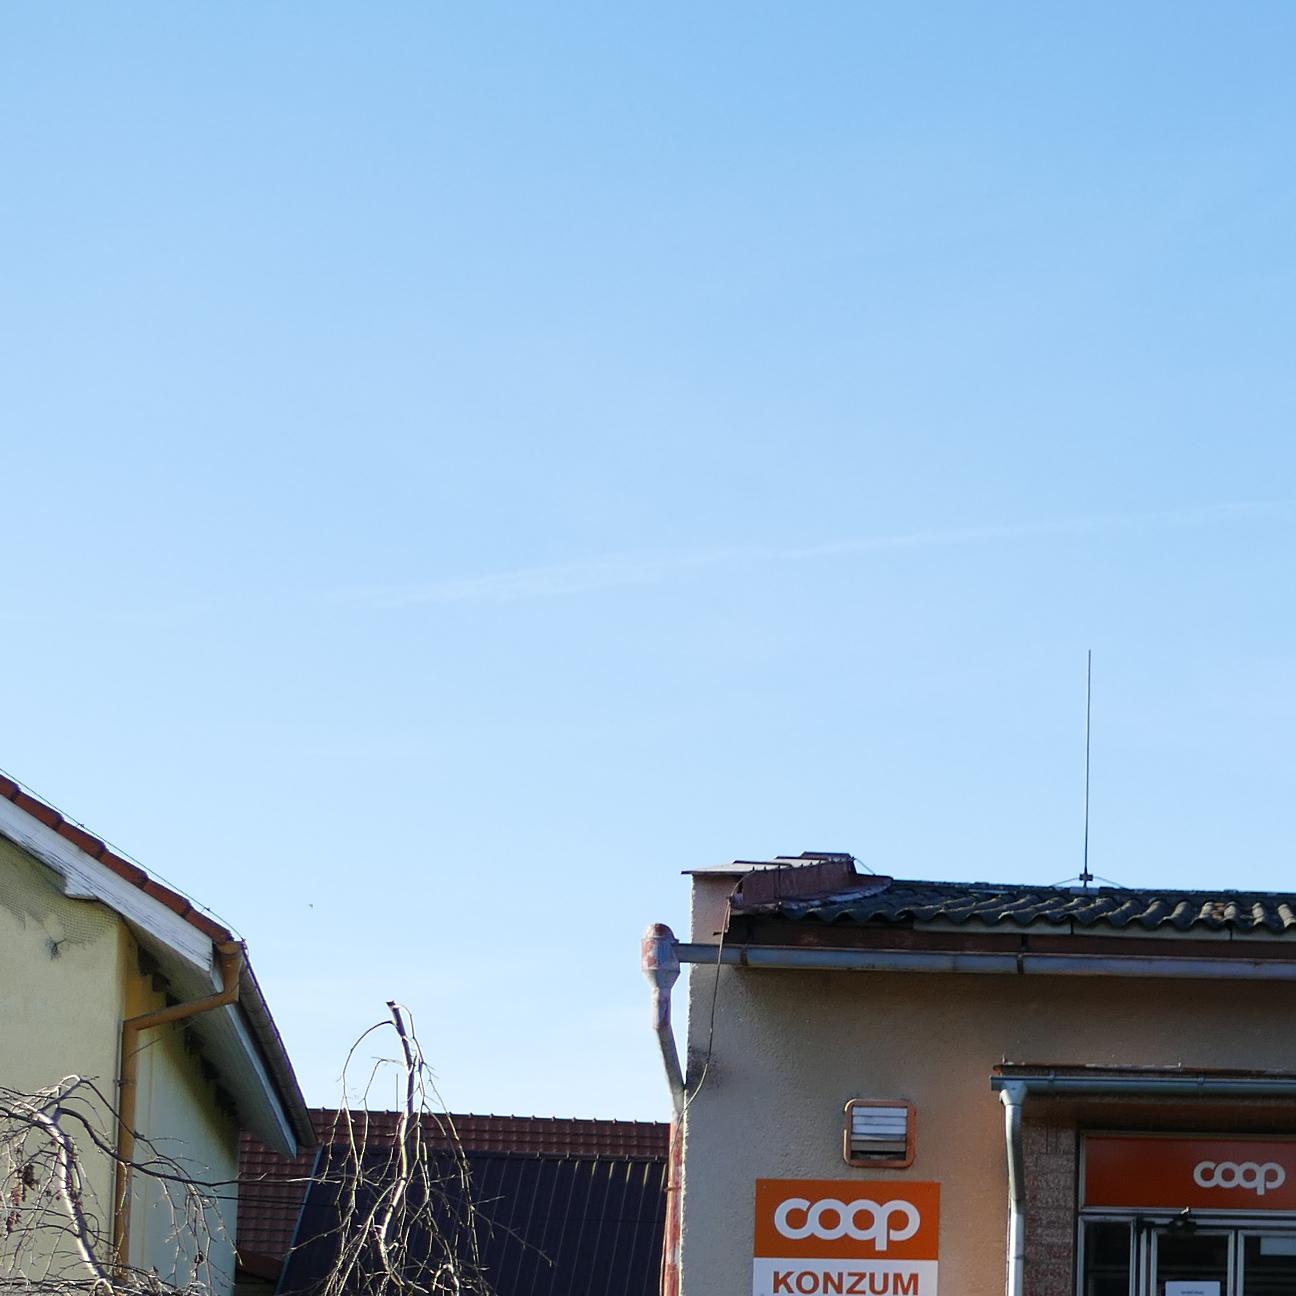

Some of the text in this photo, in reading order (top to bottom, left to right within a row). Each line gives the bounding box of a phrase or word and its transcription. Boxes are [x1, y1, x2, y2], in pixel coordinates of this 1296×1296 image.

[1193, 1161, 1286, 1196] coop
[774, 1198, 921, 1251] coop
[772, 1271, 920, 1296] KONZUM
